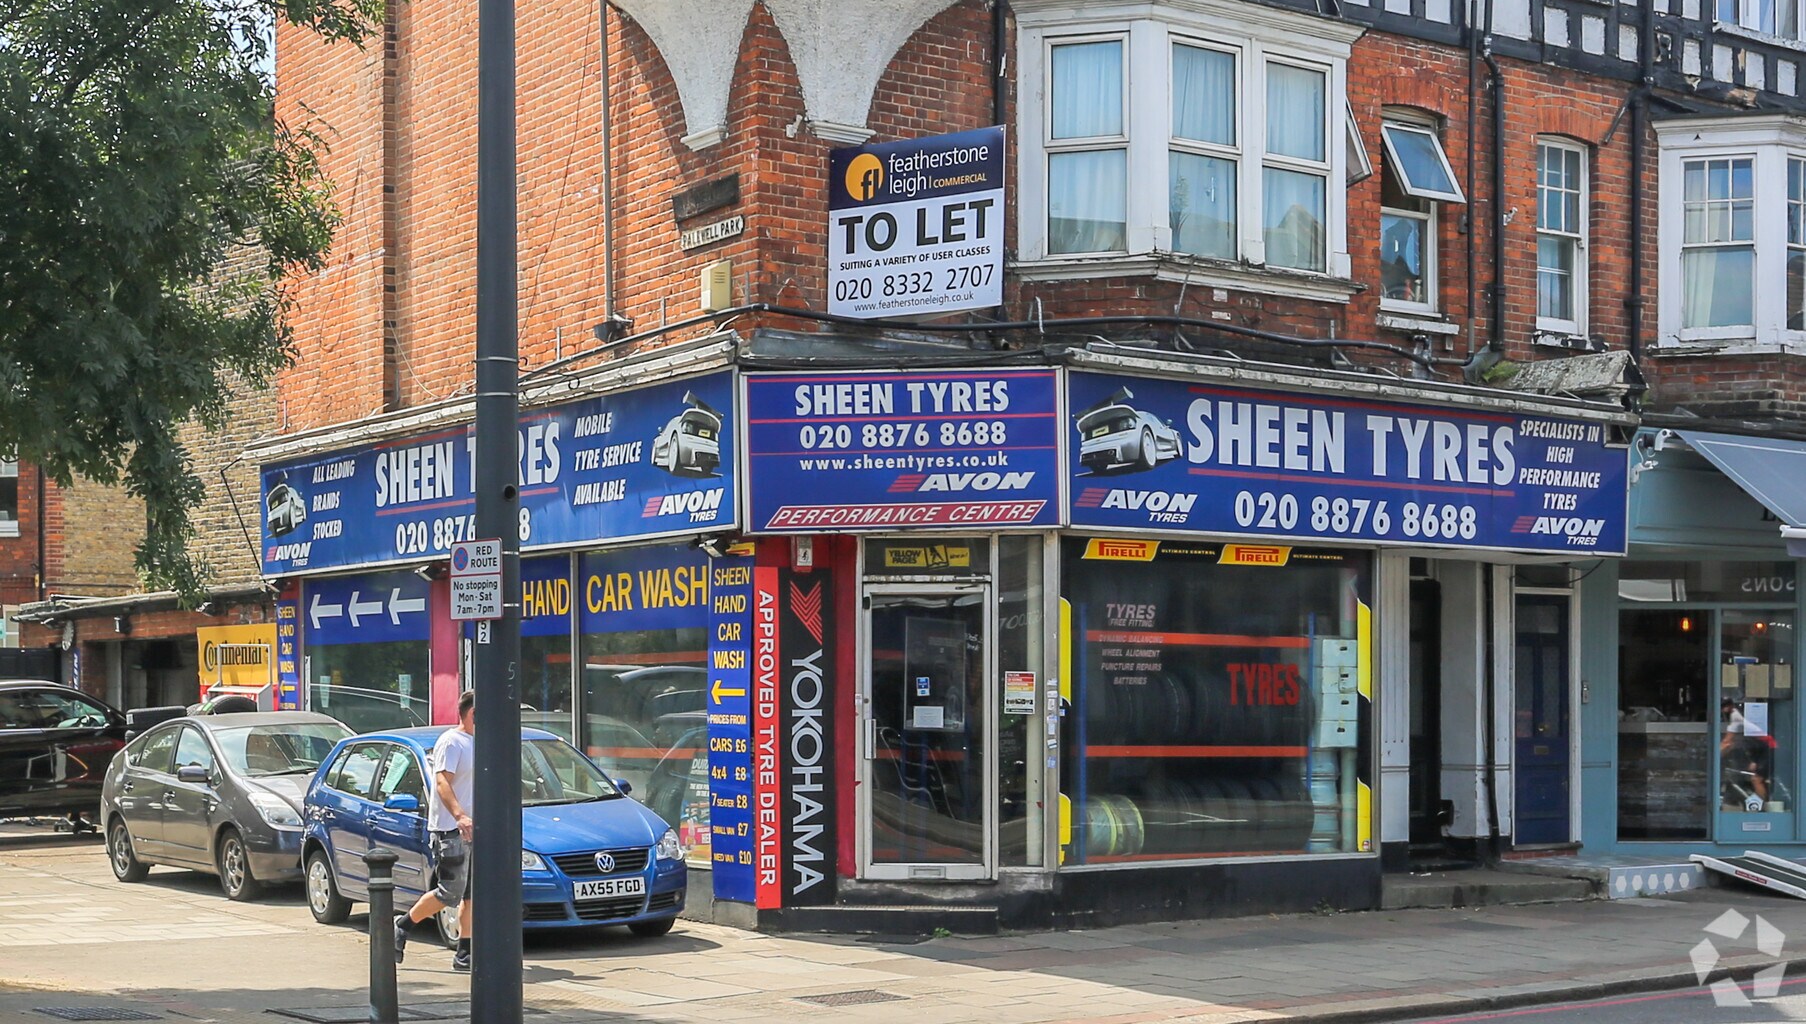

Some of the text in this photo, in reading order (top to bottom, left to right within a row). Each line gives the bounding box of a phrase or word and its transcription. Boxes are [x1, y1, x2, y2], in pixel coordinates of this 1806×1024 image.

[888, 146, 988, 173] featherstone
[889, 172, 987, 197] leigh COMMERCIAL
[720, 217, 741, 237] PARK
[838, 198, 994, 254] TO LET
[840, 245, 991, 271] SUITING A VARIETY OF USER CLASSES
[835, 264, 994, 302] 020 8332 2707
[854, 291, 974, 312] www.featherstoneleigh.co.uk
[794, 380, 1010, 416] SHEEN TYRES
[574, 412, 613, 438] MOBILE
[799, 420, 1006, 450] 020 8876 8688
[1519, 420, 1601, 443] SPECIALISTS IN
[1187, 398, 1516, 486] SHEEN TYRES
[575, 441, 643, 472] TYRE SERVICE
[799, 450, 1009, 472] www.sheentyres.co.uk
[1546, 446, 1575, 464] HIGH
[312, 460, 356, 484] ALL LEADING
[375, 441, 454, 508] SHEEN
[918, 471, 1036, 493] AVON
[1519, 467, 1601, 489] PERFORMANCE
[312, 491, 340, 512] BRANDS
[573, 479, 627, 506] AVAILABLE
[658, 488, 725, 517] AVON
[1101, 489, 1198, 513] AVON
[1543, 492, 1578, 511] TYRES
[689, 509, 718, 523] TYRES
[774, 501, 1040, 526] PERFORMANCE CENTRE
[1148, 512, 1189, 524] TYRES
[1234, 490, 1477, 540] 020 8876 8688
[312, 519, 343, 541] STOCKED
[1530, 516, 1606, 537] AVON
[396, 521, 428, 555] 020
[1566, 535, 1598, 547] TYRES
[275, 542, 312, 561] AVON
[476, 545, 493, 556] RED
[889, 549, 922, 558] YELLOW
[1098, 541, 1147, 558] PIRELLI
[1234, 547, 1280, 563] PIRELLI
[292, 558, 309, 567] TYRES
[470, 557, 498, 568] ROUTE
[453, 579, 498, 593] No stopping
[714, 567, 750, 587] SHEEN
[522, 578, 571, 617] HAND
[586, 565, 708, 614] CAR WASH
[714, 594, 746, 614] HAND
[1106, 603, 1156, 620] TYRES
[480, 631, 487, 642] 2
[717, 623, 741, 641] CAR
[281, 643, 293, 655] CAR
[1102, 648, 1161, 658] WHEEL ALIGNMENT
[280, 661, 295, 673] WASH
[713, 650, 745, 669] WASH
[1100, 662, 1162, 672] PUNCTURE REPAIRS
[508, 662, 516, 680] 5
[1113, 676, 1148, 686] BATTERIES
[1226, 662, 1301, 706] TYRES
[709, 714, 747, 725] PRICES FROM
[710, 737, 747, 753] CARS £6
[758, 590, 776, 886] APPROVED TYRE DEALER
[711, 766, 727, 780] 4x4
[735, 767, 747, 781] £8
[790, 648, 825, 896] YOKOHAMA
[711, 793, 718, 807] 7
[717, 799, 735, 808] SEATER
[736, 795, 748, 809] £8
[737, 823, 749, 837] £7
[739, 851, 752, 865] £10
[581, 879, 640, 896] AX55 FGD
